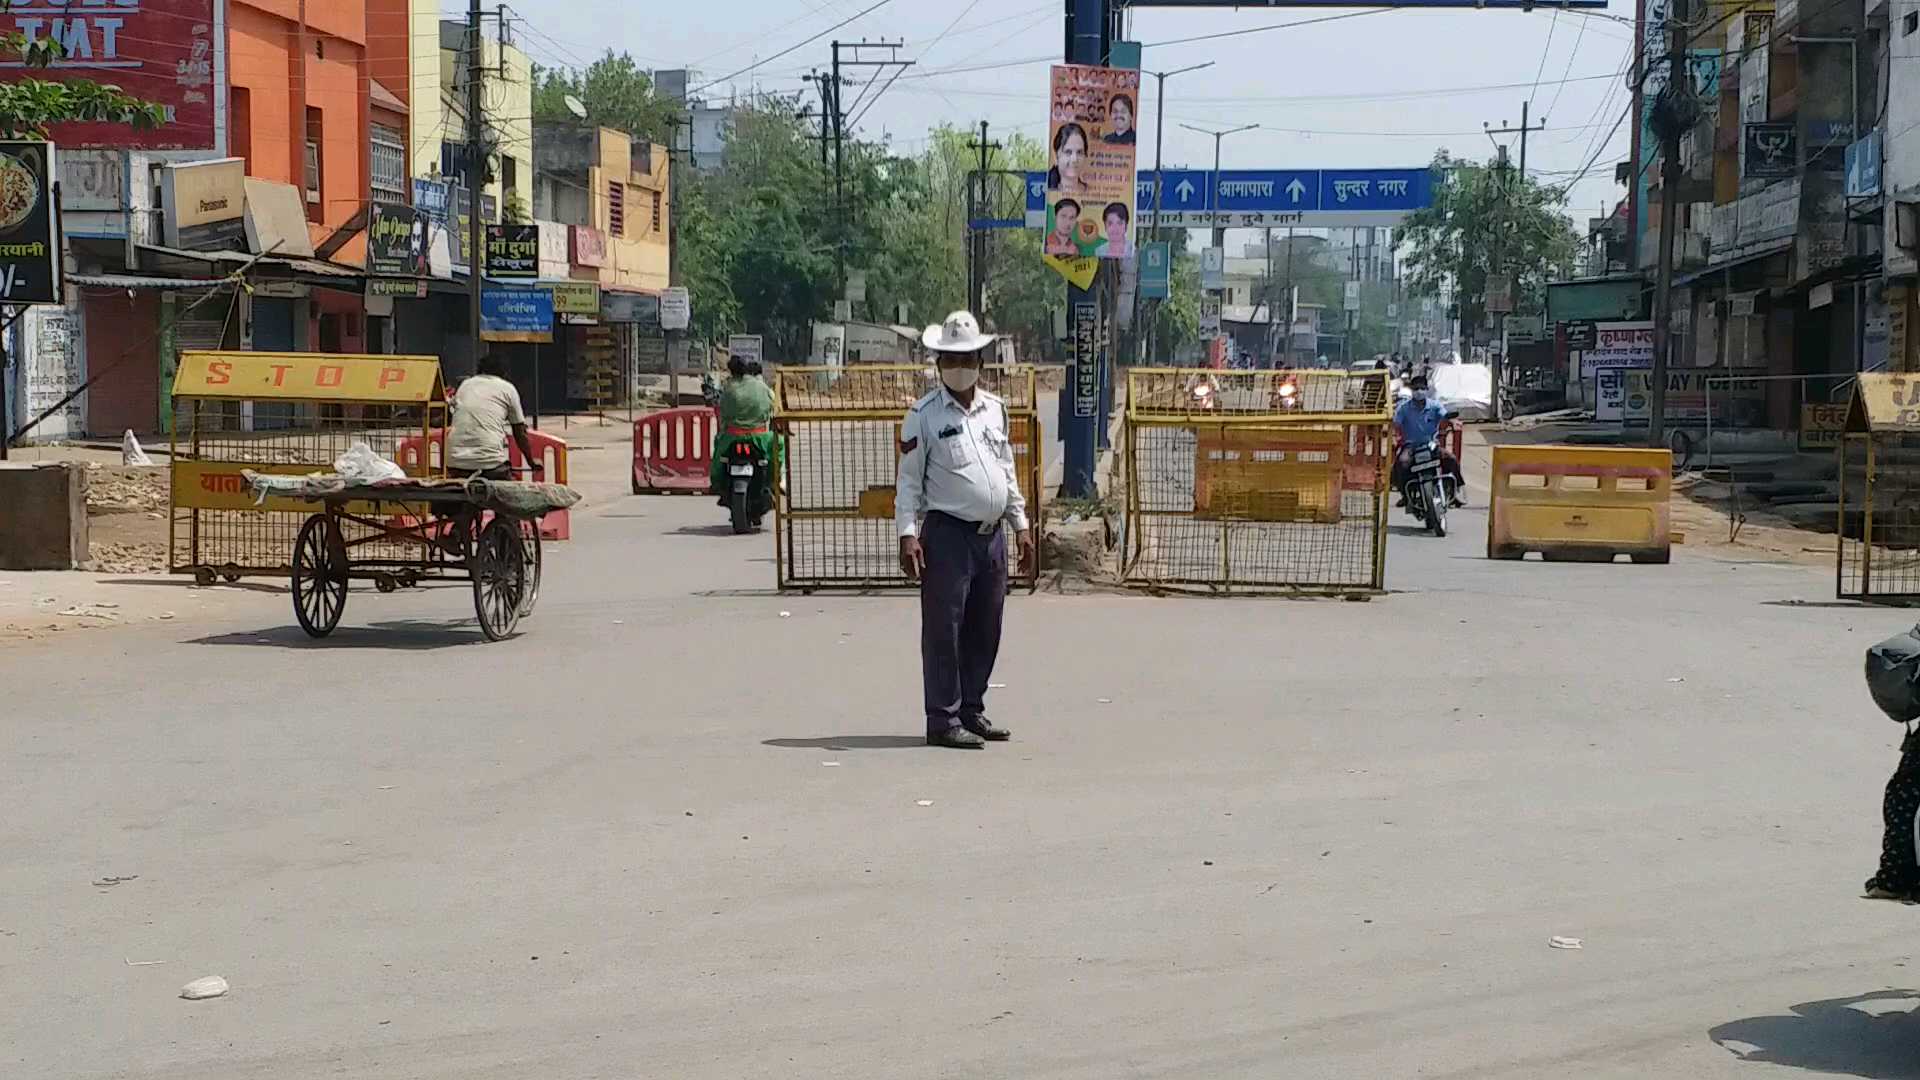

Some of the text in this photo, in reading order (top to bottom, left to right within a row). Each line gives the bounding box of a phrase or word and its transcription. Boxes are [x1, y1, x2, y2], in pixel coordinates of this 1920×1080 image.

[1218, 180, 1275, 198] आमापारा
[1333, 179, 1409, 202] सुन्दर नगर
[1272, 210, 1304, 224] मार्ग
[0, 241, 45, 257] रयानी
